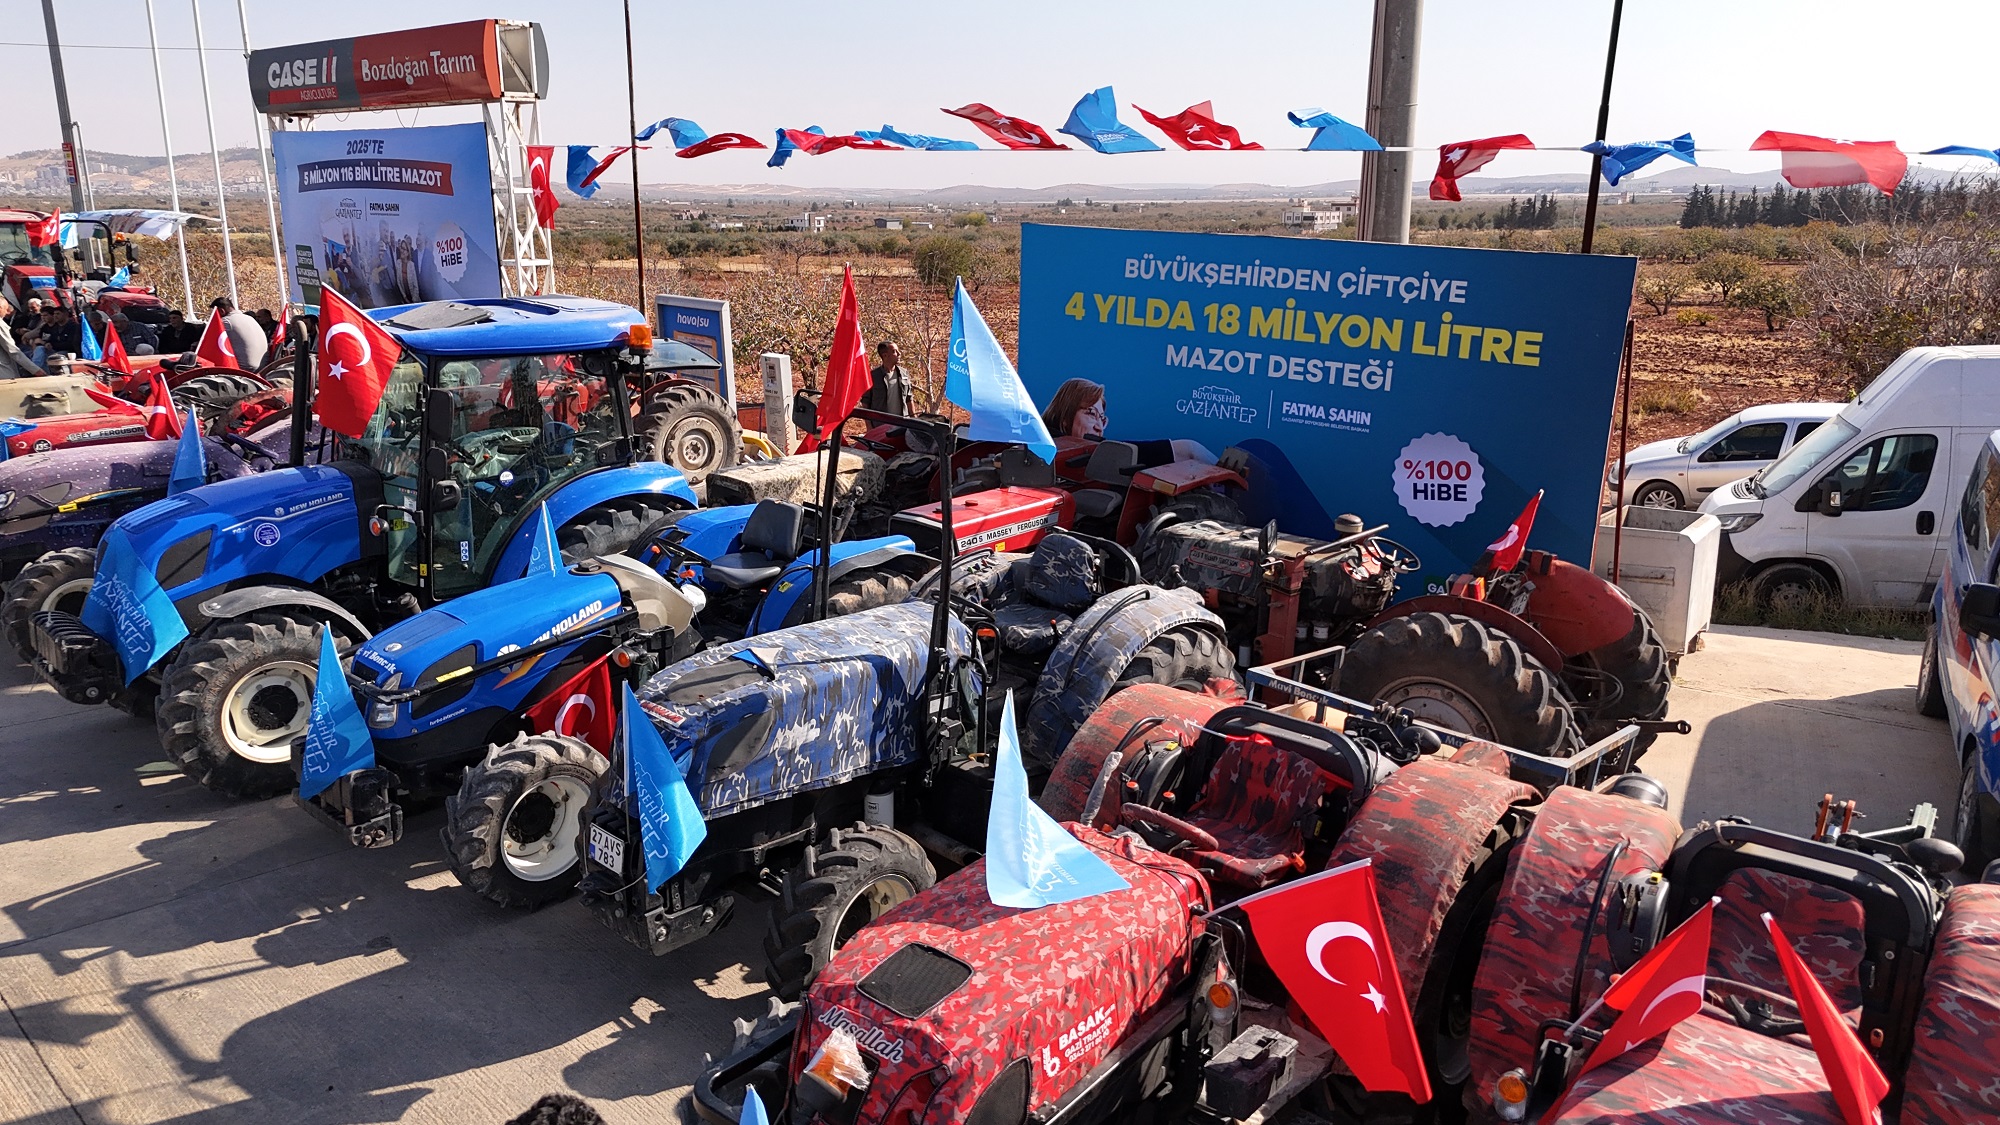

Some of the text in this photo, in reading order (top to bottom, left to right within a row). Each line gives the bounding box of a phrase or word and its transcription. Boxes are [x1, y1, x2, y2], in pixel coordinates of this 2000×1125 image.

[267, 58, 317, 89] CASE
[361, 50, 476, 85] Bozdoğan Tarım
[300, 86, 336, 101] AGRICULTURE
[346, 139, 385, 155] 2025'TE
[303, 161, 442, 187] 5 MİLYON 116 BİN LİTRE MAZOT
[436, 236, 463, 255] %100
[1124, 252, 1469, 304] BÜYÜKŞEHİRDEN ÇİFTÇİYE
[1064, 291, 1544, 367] 4 YILDA 18 MİLYON LİTRE
[1165, 344, 1394, 392] MAZOT DESTEĞİ
[1282, 401, 1326, 420] FATMA
[99, 426, 145, 437] FERGUSON
[1403, 459, 1472, 481] %100
[289, 492, 344, 513] NEW HOLLAND
[960, 537, 978, 548] 240
[986, 526, 1013, 541] MASSEY
[1017, 517, 1049, 532] FERGUSON
[551, 599, 603, 636] HOLLAND
[591, 828, 621, 856] 27 AVS
[598, 847, 615, 868] 783
